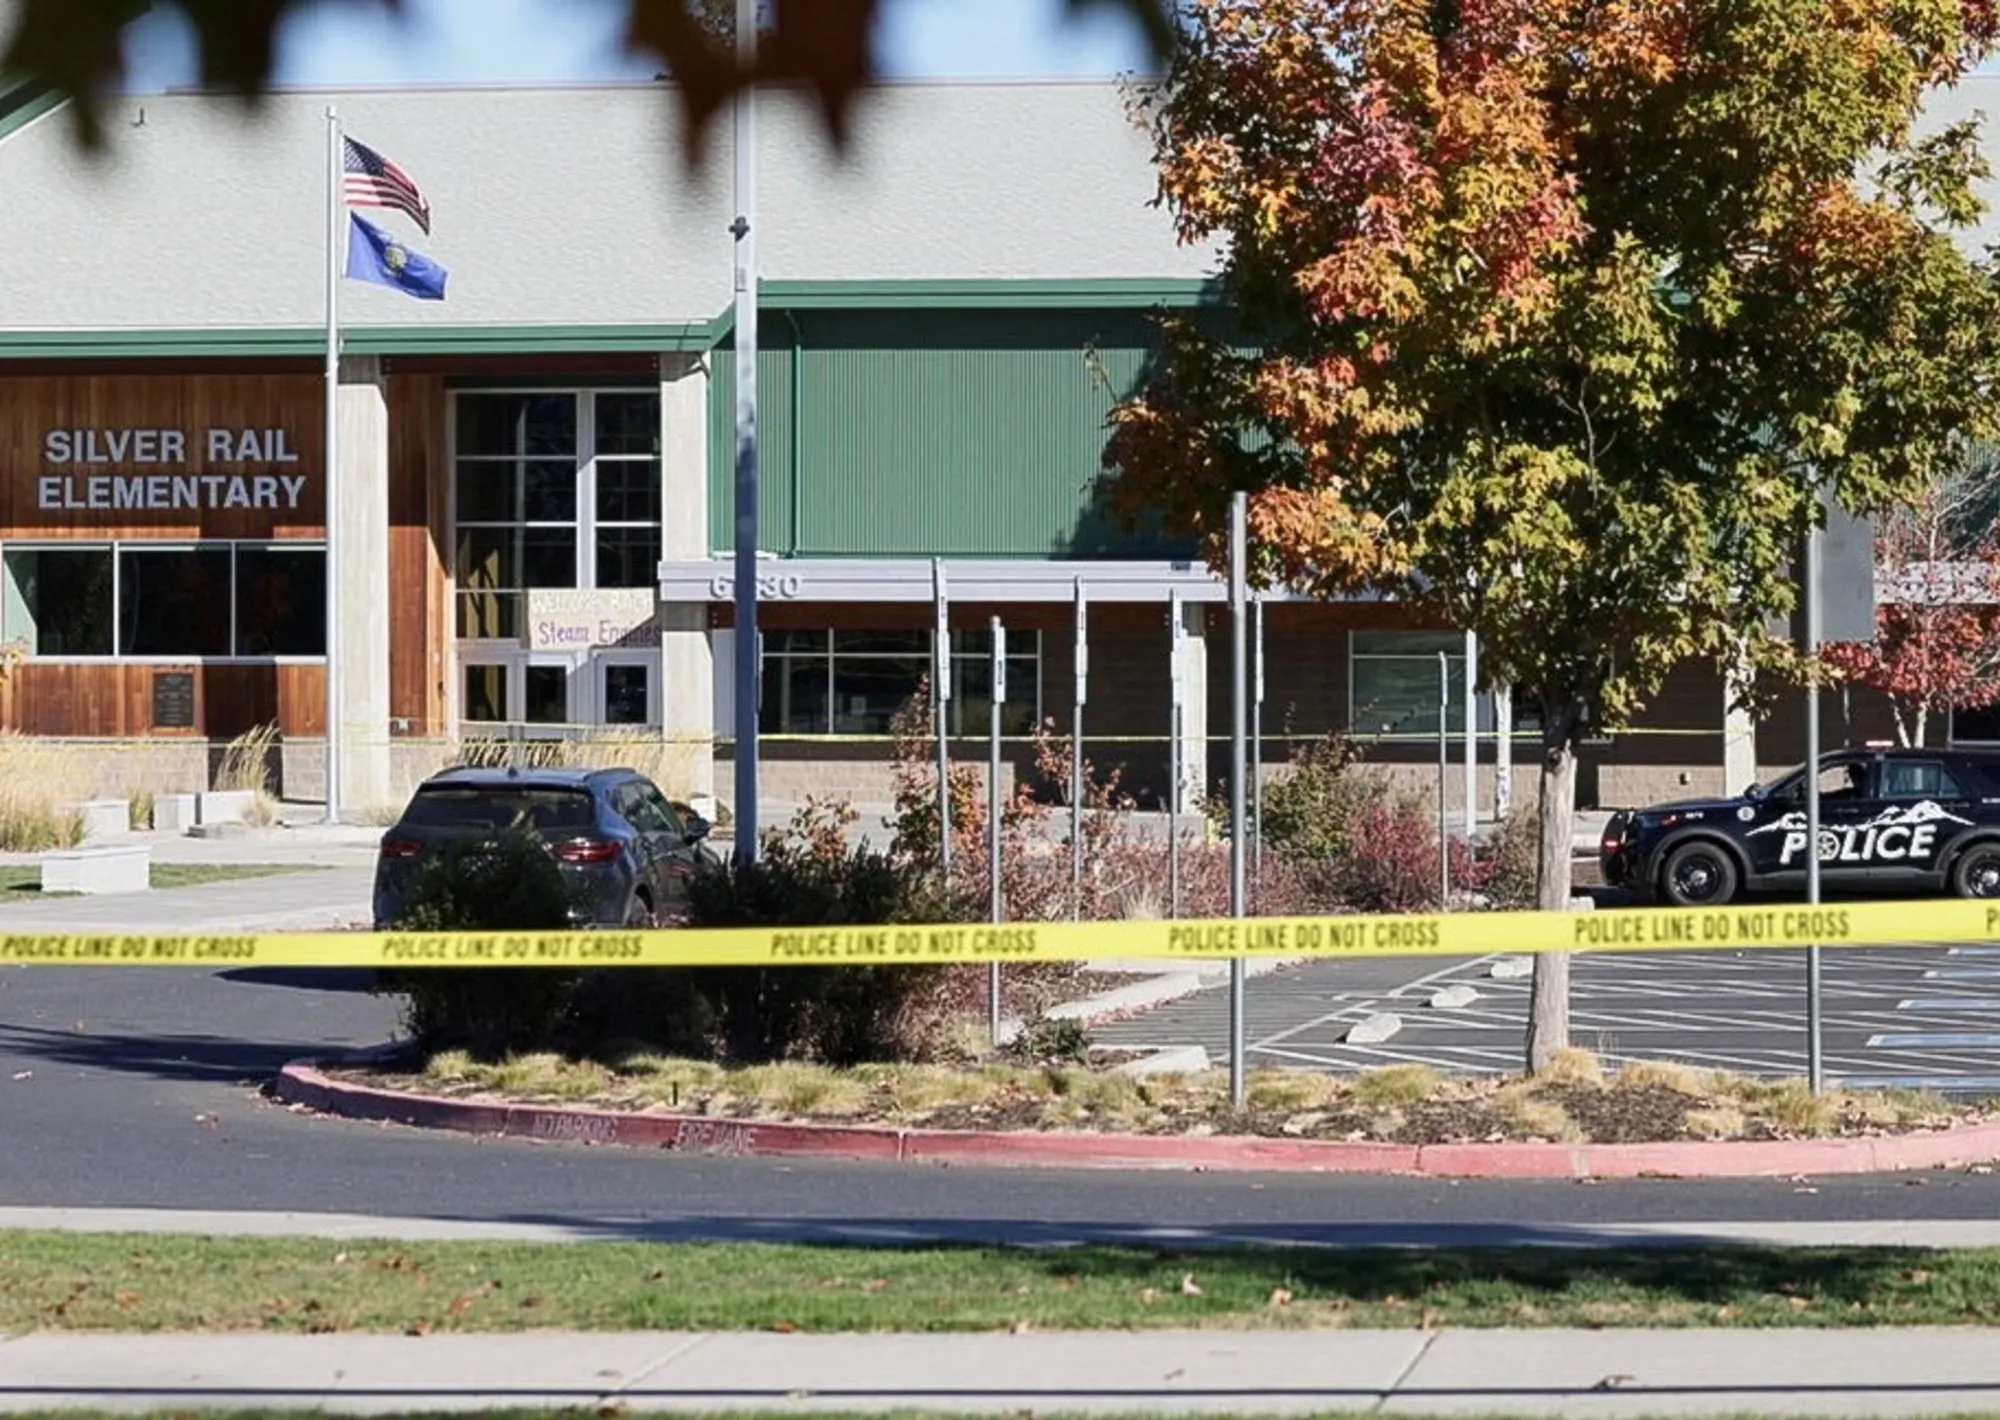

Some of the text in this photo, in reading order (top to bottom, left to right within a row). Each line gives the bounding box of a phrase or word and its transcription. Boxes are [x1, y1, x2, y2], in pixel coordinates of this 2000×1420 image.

[45, 428, 299, 464] SILVER RAIL
[38, 475, 306, 509] ELEMENTARY
[538, 622, 590, 646] Steam
[1779, 824, 1938, 865] POLICE
[1169, 921, 1440, 950] POLICE LINE DO NOT CROSS
[1575, 911, 1850, 943] POLICE LINE DO NOT CROSS
[3, 936, 257, 957] POLICE LINE DO NOT CROSS
[382, 935, 643, 958] POLICE LINE DO NOT CROSS
[771, 929, 1037, 956] POLICE LINE DO NOT CROSS
